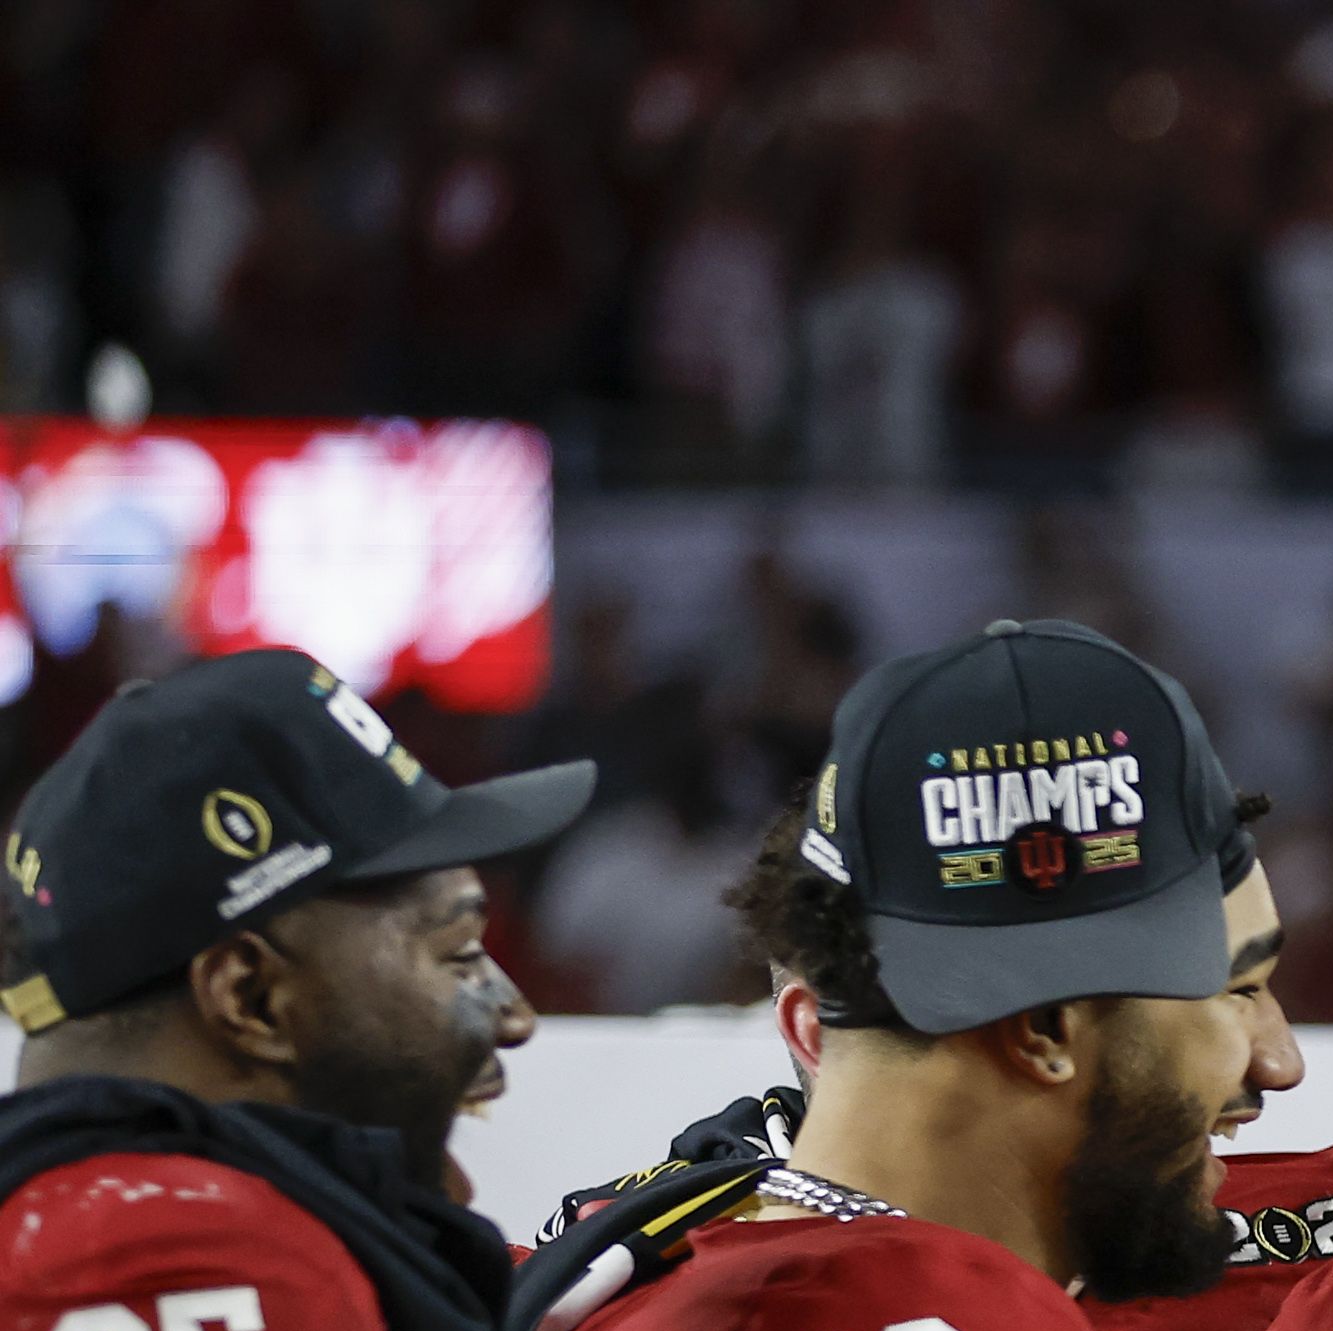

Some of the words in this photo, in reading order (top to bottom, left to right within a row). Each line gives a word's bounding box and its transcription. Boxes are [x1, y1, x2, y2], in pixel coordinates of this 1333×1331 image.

[951, 732, 1109, 771] NATIONAL
[921, 755, 1144, 847] CHAMPS
[940, 851, 1005, 885] 20
[1083, 833, 1141, 868] 25
